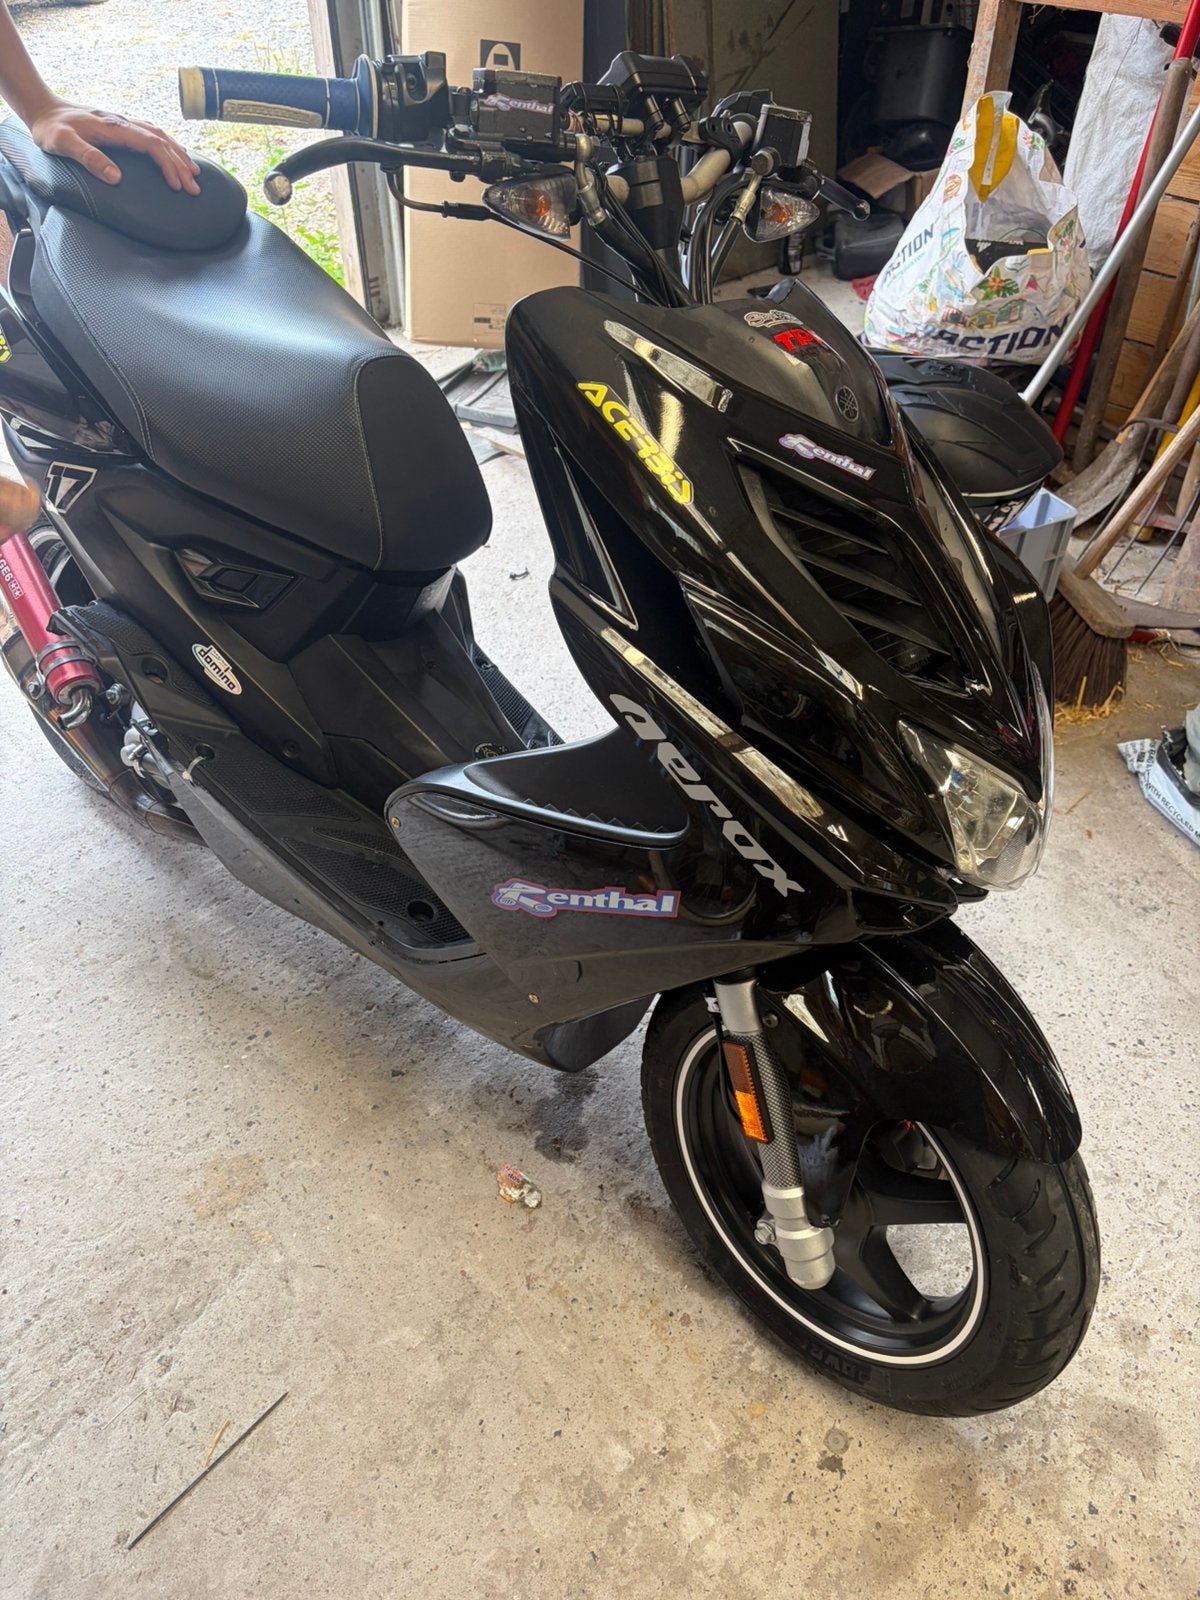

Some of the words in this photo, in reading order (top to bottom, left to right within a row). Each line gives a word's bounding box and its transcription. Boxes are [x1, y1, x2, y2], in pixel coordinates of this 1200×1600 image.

[485, 94, 554, 114] Renthal
[780, 435, 873, 478] Renthal
[49, 464, 94, 510] 17
[198, 646, 236, 691] domino
[609, 693, 806, 898] aerox
[1160, 797, 1195, 832] RECYCLED
[497, 881, 676, 914] Renthal
